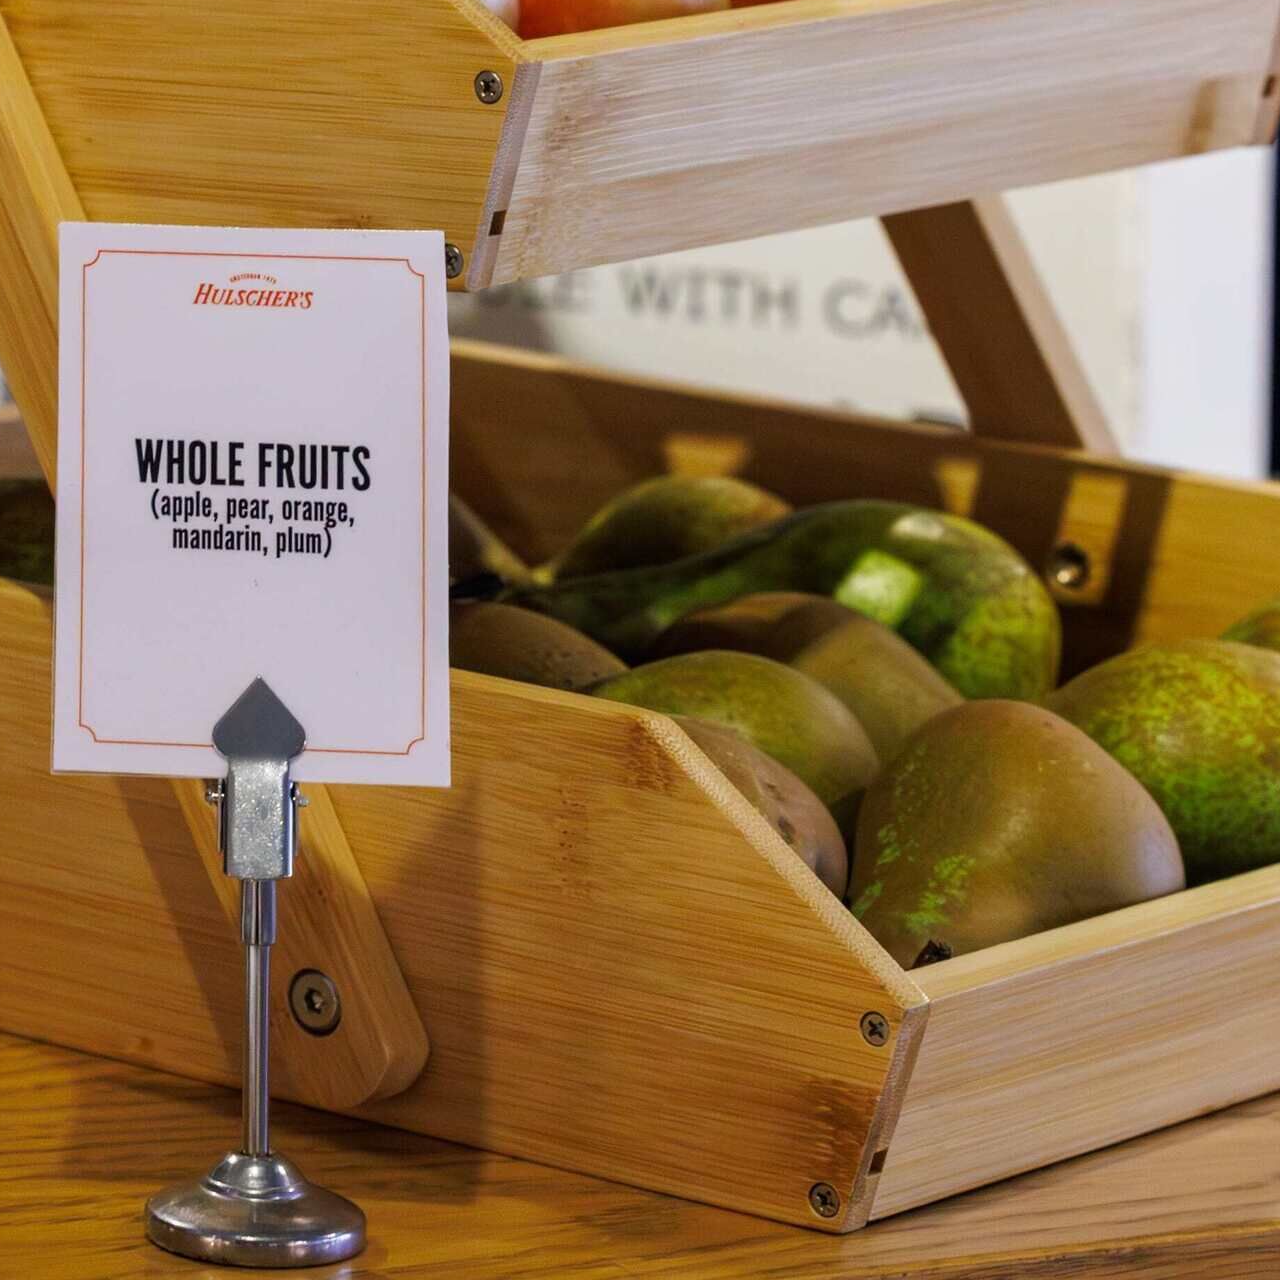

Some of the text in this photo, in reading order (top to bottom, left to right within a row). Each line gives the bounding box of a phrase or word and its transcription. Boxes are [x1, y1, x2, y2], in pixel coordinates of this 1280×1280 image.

[618, 267, 800, 331] WITH
[822, 273, 922, 342] CA
[135, 438, 371, 491] WHOLE FRUITS
[151, 488, 355, 528] (apple, pear, orange,
[172, 524, 332, 558] mandarin, plum)
